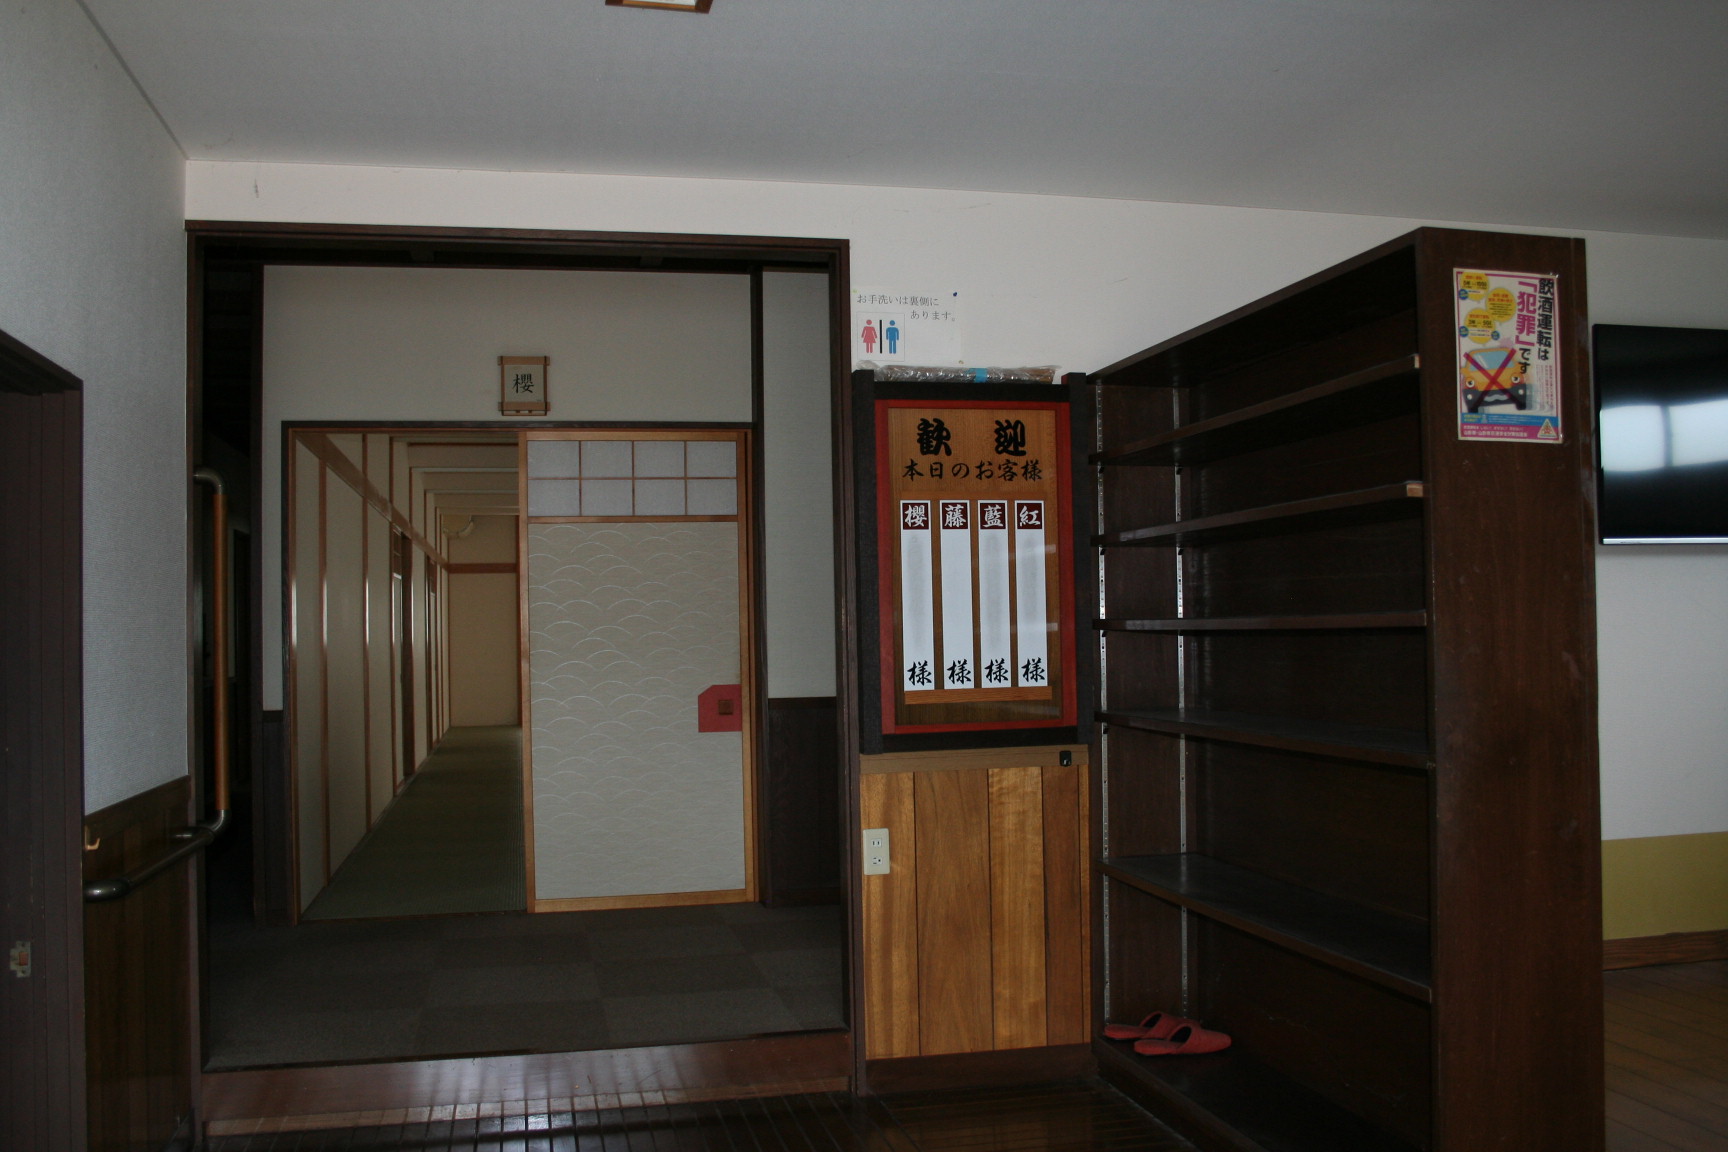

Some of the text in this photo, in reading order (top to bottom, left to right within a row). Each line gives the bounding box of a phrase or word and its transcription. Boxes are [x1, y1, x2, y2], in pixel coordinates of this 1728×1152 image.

[857, 294, 940, 307] お手洗いは裏側に
[910, 309, 956, 322] あります。
[1536, 278, 1555, 361] 飲酒運転は
[512, 373, 535, 394] 櫻
[901, 458, 1043, 482] 本日のお客様
[904, 504, 932, 686] 櫻 様
[943, 503, 972, 685] 藤 様
[982, 504, 1009, 684] 藍 様
[1018, 505, 1046, 683] 紅 様
